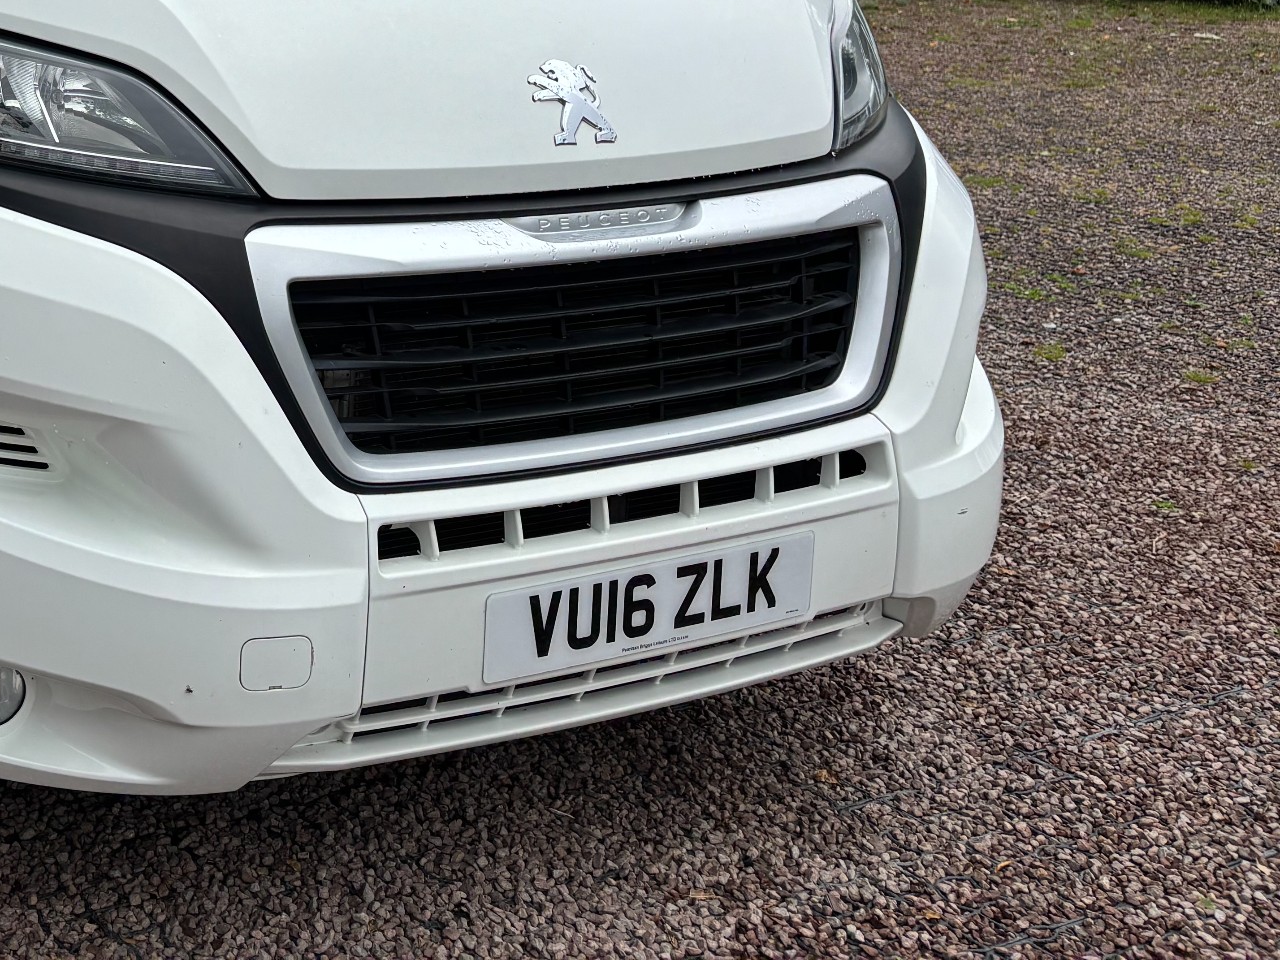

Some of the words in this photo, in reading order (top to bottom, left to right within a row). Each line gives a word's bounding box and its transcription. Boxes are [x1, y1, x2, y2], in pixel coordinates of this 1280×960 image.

[538, 207, 668, 232] PEUGEOT
[529, 572, 657, 658] VU16
[673, 547, 780, 630] ZLK
